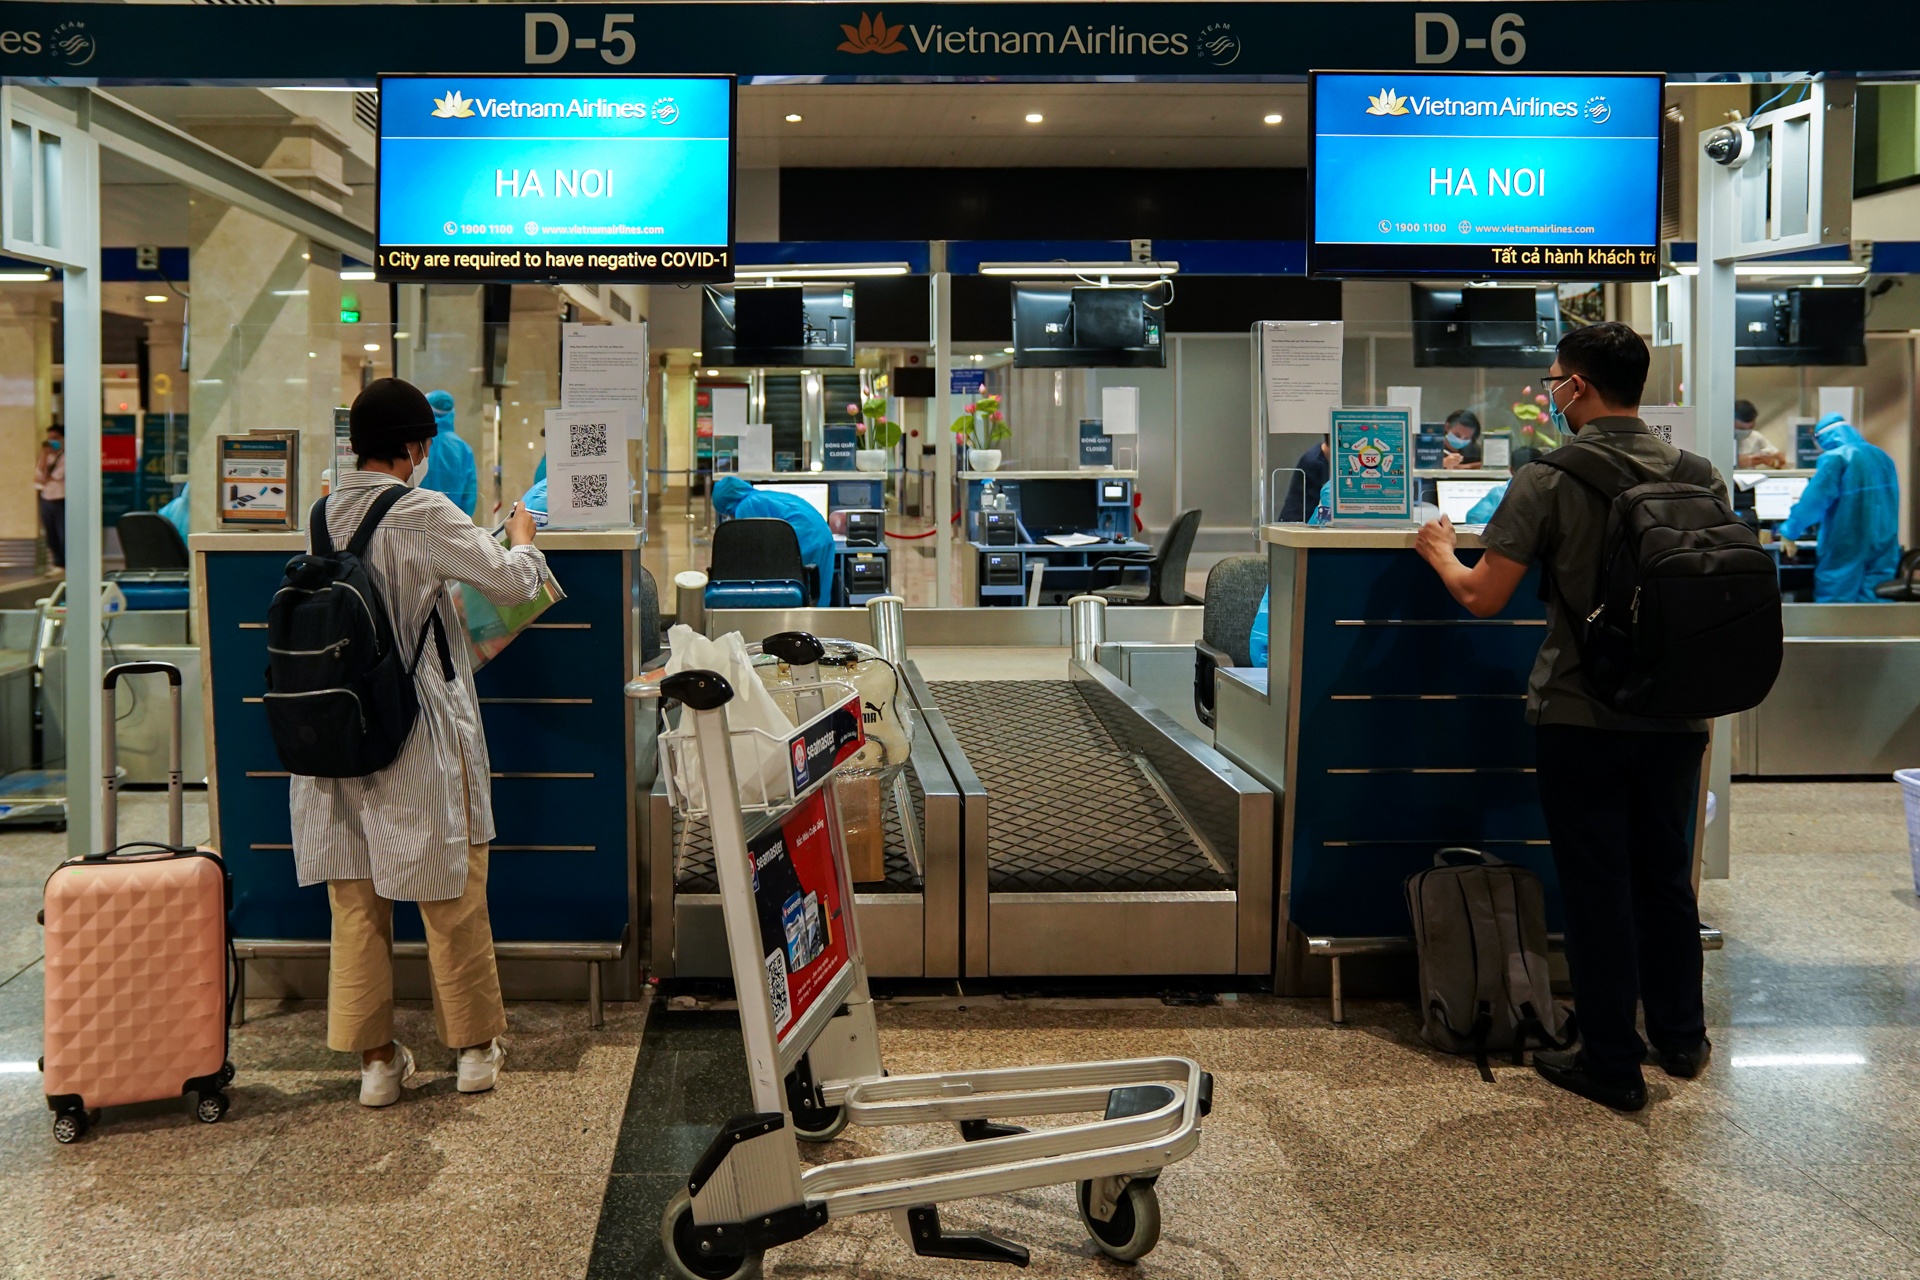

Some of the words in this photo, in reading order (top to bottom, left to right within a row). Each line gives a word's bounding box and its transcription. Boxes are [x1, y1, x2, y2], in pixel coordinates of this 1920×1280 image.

[0, 30, 42, 54] es
[524, 12, 637, 66] D-5
[910, 24, 1054, 55] Vietnam
[1058, 24, 1189, 55] Airlines
[1414, 12, 1527, 65] D-6
[475, 97, 564, 118] Vietnam
[565, 97, 647, 118] Airlines
[1409, 95, 1498, 116] Vietnam
[1498, 96, 1579, 117] Airlines
[496, 168, 546, 198] HA
[555, 168, 614, 198] NOI
[1430, 167, 1478, 197] HA
[1488, 168, 1545, 197] NOI
[460, 223, 487, 235] 1900
[488, 223, 514, 235] 1100
[541, 223, 665, 236] www.vietnamairlines.com
[1394, 222, 1421, 233] 1900
[1422, 222, 1447, 233] 1100
[1474, 223, 1595, 234] www.vietnamairlines.com
[388, 250, 421, 271] City
[423, 255, 451, 268] are
[453, 250, 521, 271] required
[523, 252, 542, 268] to
[545, 250, 585, 268] have
[588, 251, 658, 271] negative
[1491, 246, 1518, 264] Tất
[1521, 247, 1541, 265] cả
[1544, 248, 1584, 265] hành
[1588, 248, 1636, 265] khách
[1365, 456, 1377, 464] 5K
[806, 729, 835, 761] seamaster
[756, 839, 783, 871] seamaster
